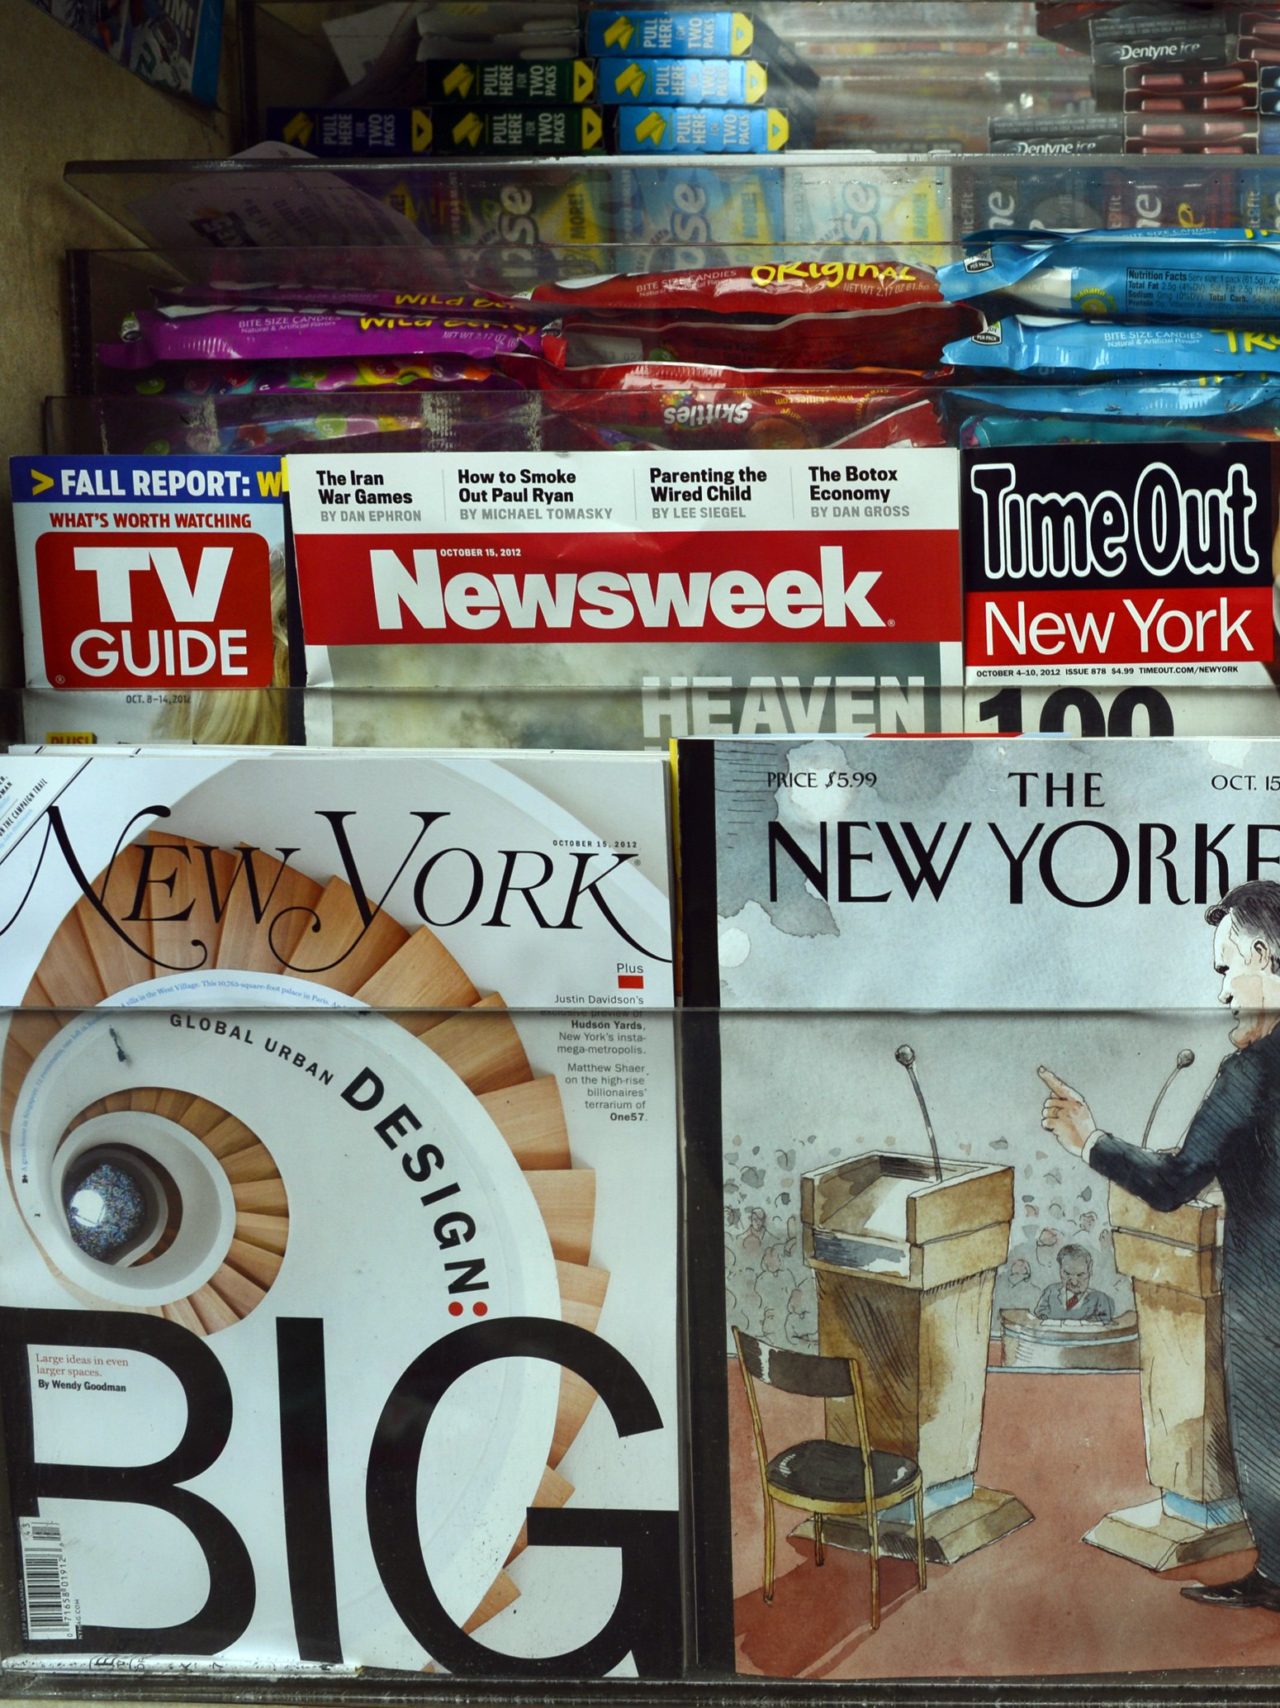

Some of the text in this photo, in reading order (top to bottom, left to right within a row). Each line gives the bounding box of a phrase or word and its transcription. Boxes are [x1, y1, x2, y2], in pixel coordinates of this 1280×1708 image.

[1119, 42, 1200, 59] Dentyne ice
[483, 66, 499, 96] PULL
[499, 65, 514, 96] HERE
[530, 65, 544, 96] TWO
[544, 66, 558, 97] PACKS
[664, 401, 752, 424] Skittles
[61, 468, 251, 496] FALL REPORT:
[316, 470, 384, 486] The Iran
[808, 466, 898, 482] The Botox
[318, 489, 413, 505] War Games
[810, 486, 890, 503] Economy
[49, 514, 252, 528] WHAT'S WORTH WATCHING
[320, 509, 422, 522] BY DAN EPHRON
[810, 504, 910, 518] BY DAN GROSS
[971, 461, 1261, 580] Time Out
[440, 548, 521, 558] OCTOBER 15, 2012
[74, 546, 234, 622] TV
[369, 545, 884, 631] Newsweek
[986, 596, 1254, 656] New York
[70, 628, 248, 676] GUIDE
[1140, 666, 1238, 674] TIMEOUT.COM/NEWYORK
[642, 676, 925, 738] HEAVEN
[980, 686, 1174, 737] 100
[767, 770, 877, 790] PRICE $5.99
[1008, 772, 1105, 808] THE
[1211, 774, 1258, 792] OCT.
[768, 820, 971, 904] NEW
[0, 805, 672, 973] NEW YORK
[616, 963, 644, 974] Plus
[571, 1021, 646, 1030] Hudson Yards,
[559, 1032, 646, 1042] New York's insta-
[169, 1013, 254, 1044] GLOBAL
[264, 1038, 334, 1086] URBAN
[36, 1354, 63, 1365] Large
[67, 1354, 91, 1364] ideas
[94, 1356, 103, 1365] in
[37, 1365, 102, 1377] larger spaces.
[38, 1379, 126, 1392] By Wendy Goodman
[0, 1306, 681, 1679] BIG
